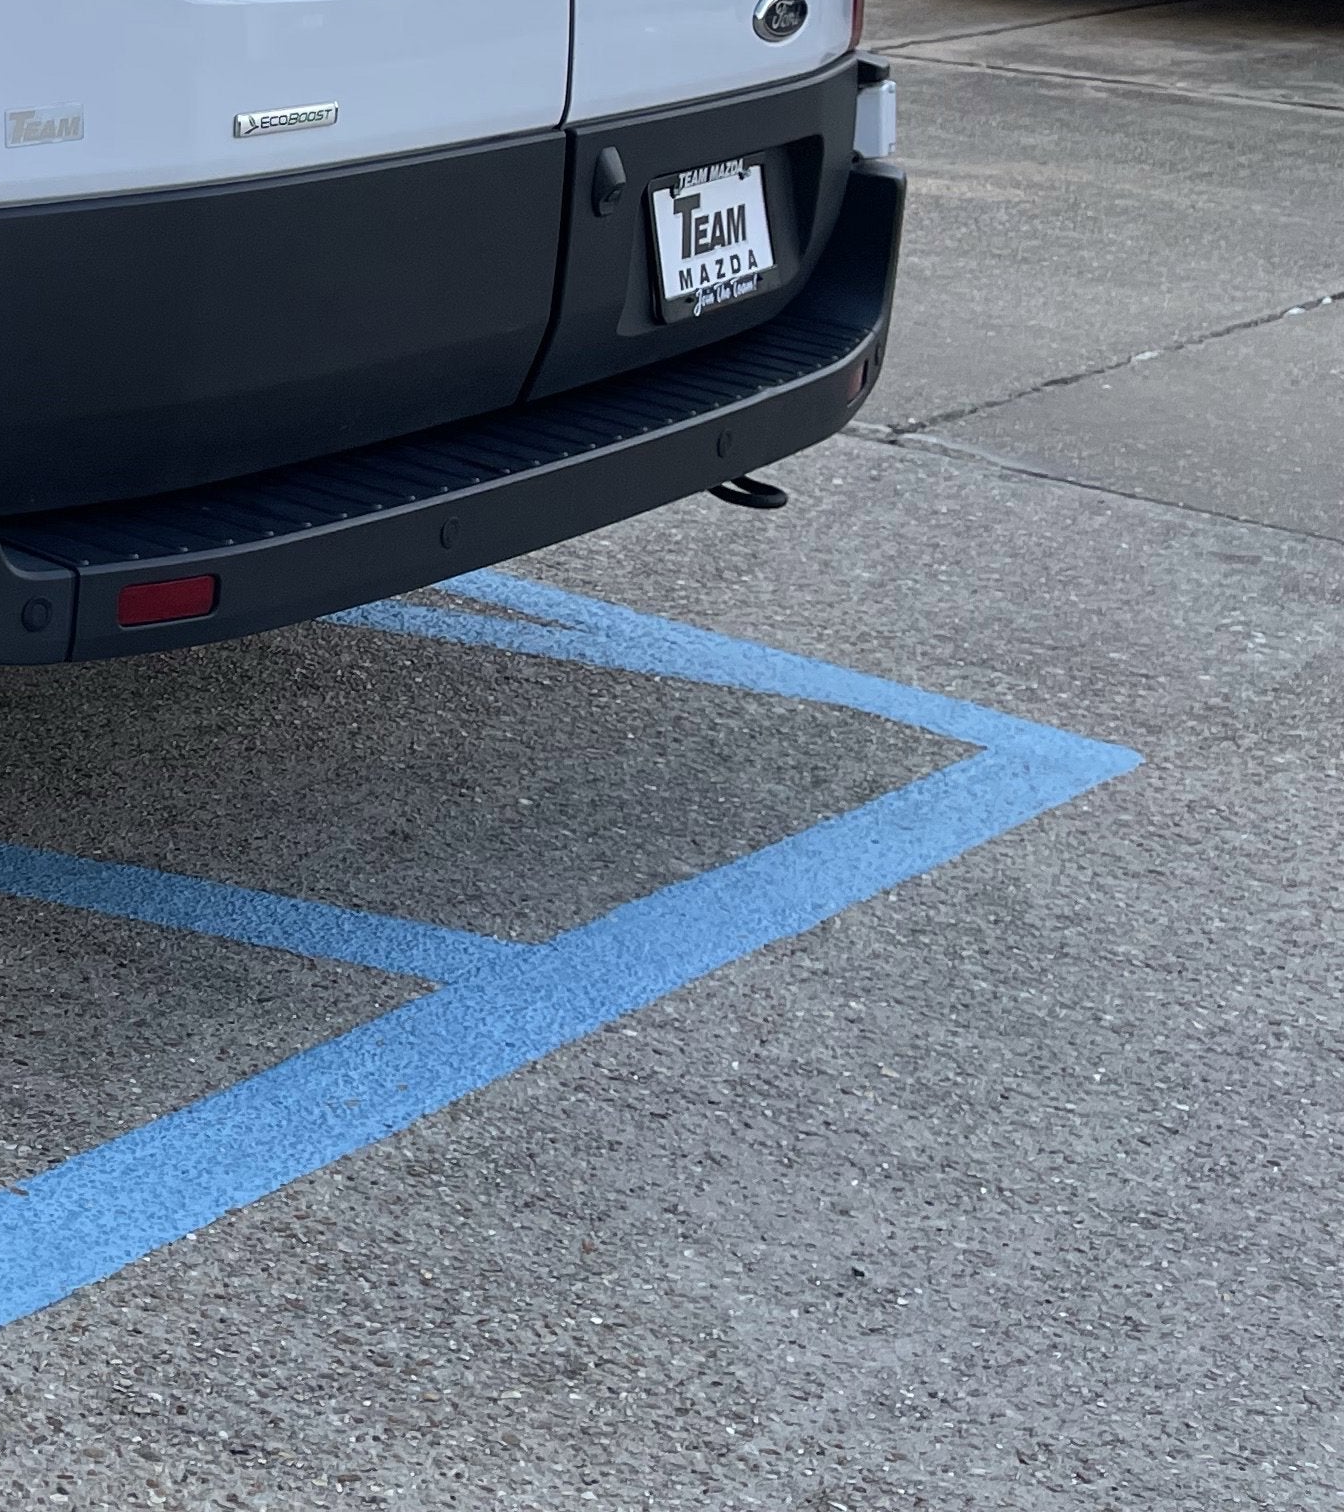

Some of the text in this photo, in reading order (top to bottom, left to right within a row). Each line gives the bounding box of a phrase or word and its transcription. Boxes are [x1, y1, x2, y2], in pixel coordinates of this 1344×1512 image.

[8, 109, 81, 145] TEAM
[678, 157, 744, 188] TEAM MAZDA
[673, 192, 747, 260] TEAM
[678, 249, 759, 291] MAZDA
